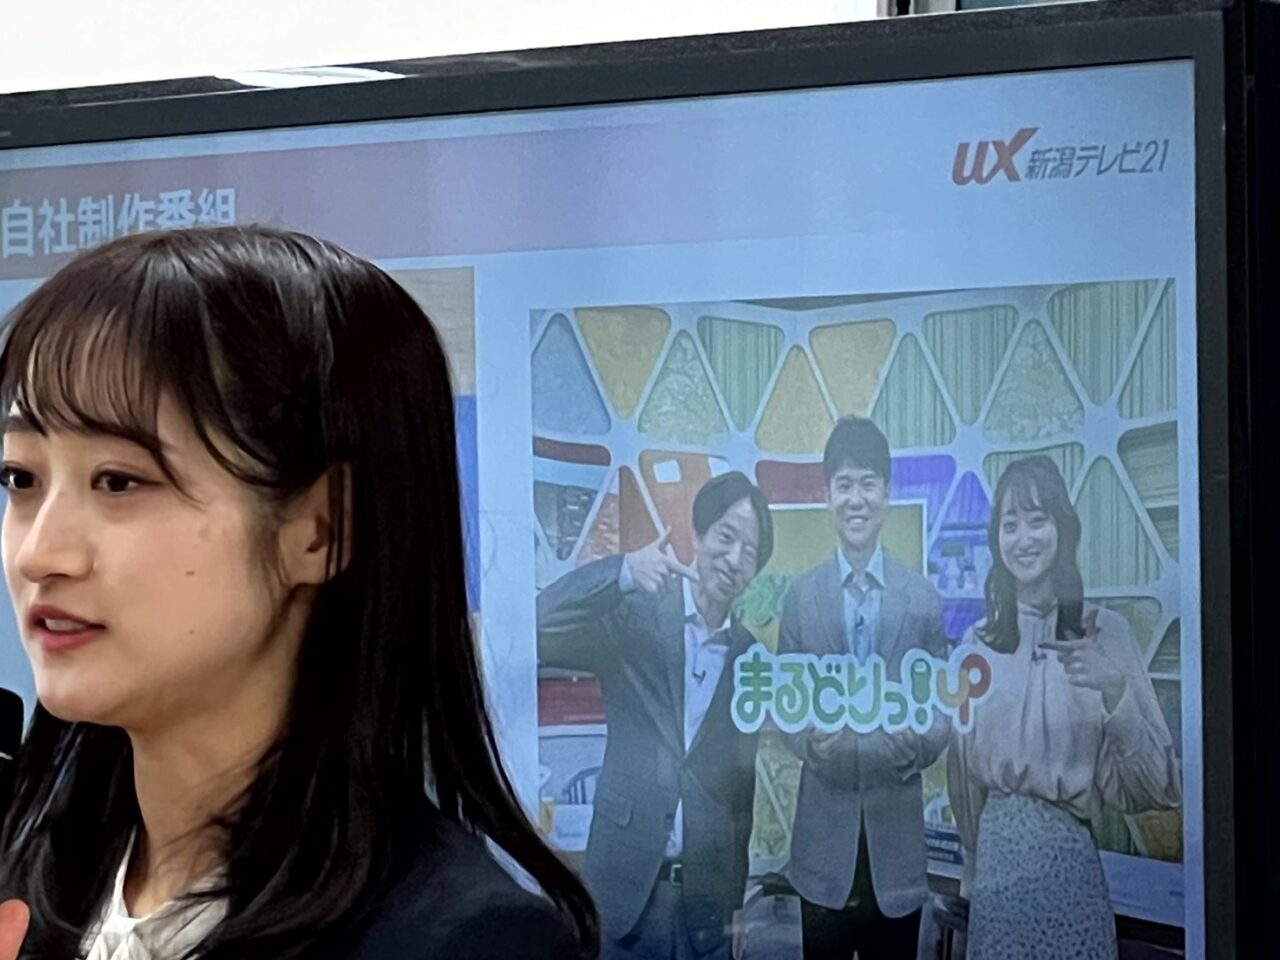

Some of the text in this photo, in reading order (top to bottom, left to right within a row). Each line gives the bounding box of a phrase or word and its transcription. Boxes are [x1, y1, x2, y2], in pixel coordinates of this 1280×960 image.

[1024, 139, 1169, 180] 新潟テレビ21
[2, 187, 236, 259] 自社制作番組
